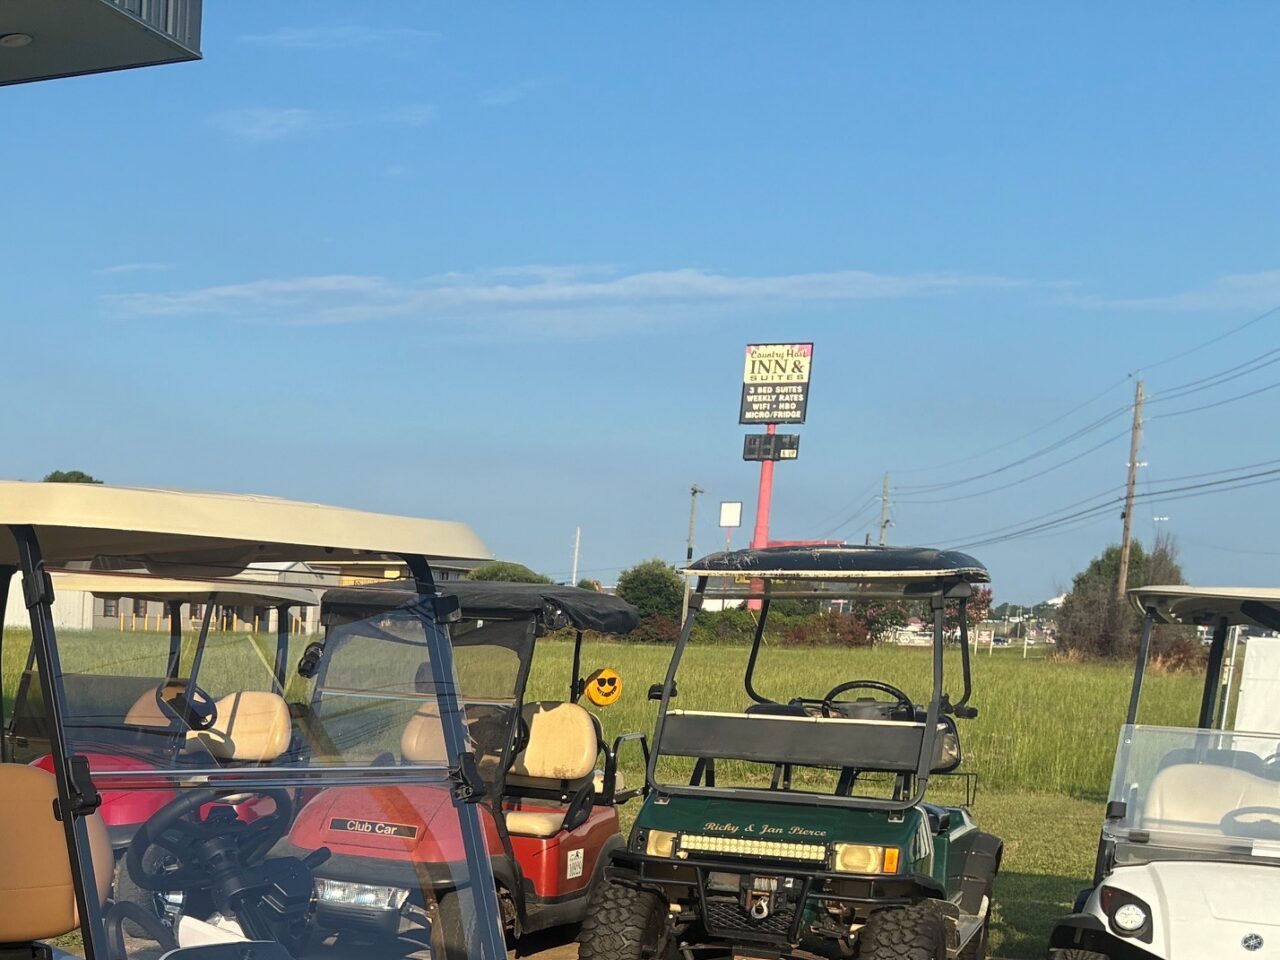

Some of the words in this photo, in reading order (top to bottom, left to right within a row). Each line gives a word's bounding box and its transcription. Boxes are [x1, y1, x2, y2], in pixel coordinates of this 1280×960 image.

[750, 359, 788, 374] INN
[791, 360, 804, 373] &
[757, 386, 773, 394] BED
[747, 394, 777, 402] WEEKLY
[778, 394, 804, 402] RATES
[745, 410, 801, 419] MICRO/FRIDGE
[346, 820, 372, 832] Club
[375, 823, 398, 835] Car
[703, 822, 739, 834] Ricky
[744, 823, 755, 832] &
[759, 824, 784, 835] Jan
[788, 825, 827, 837] Pierce
